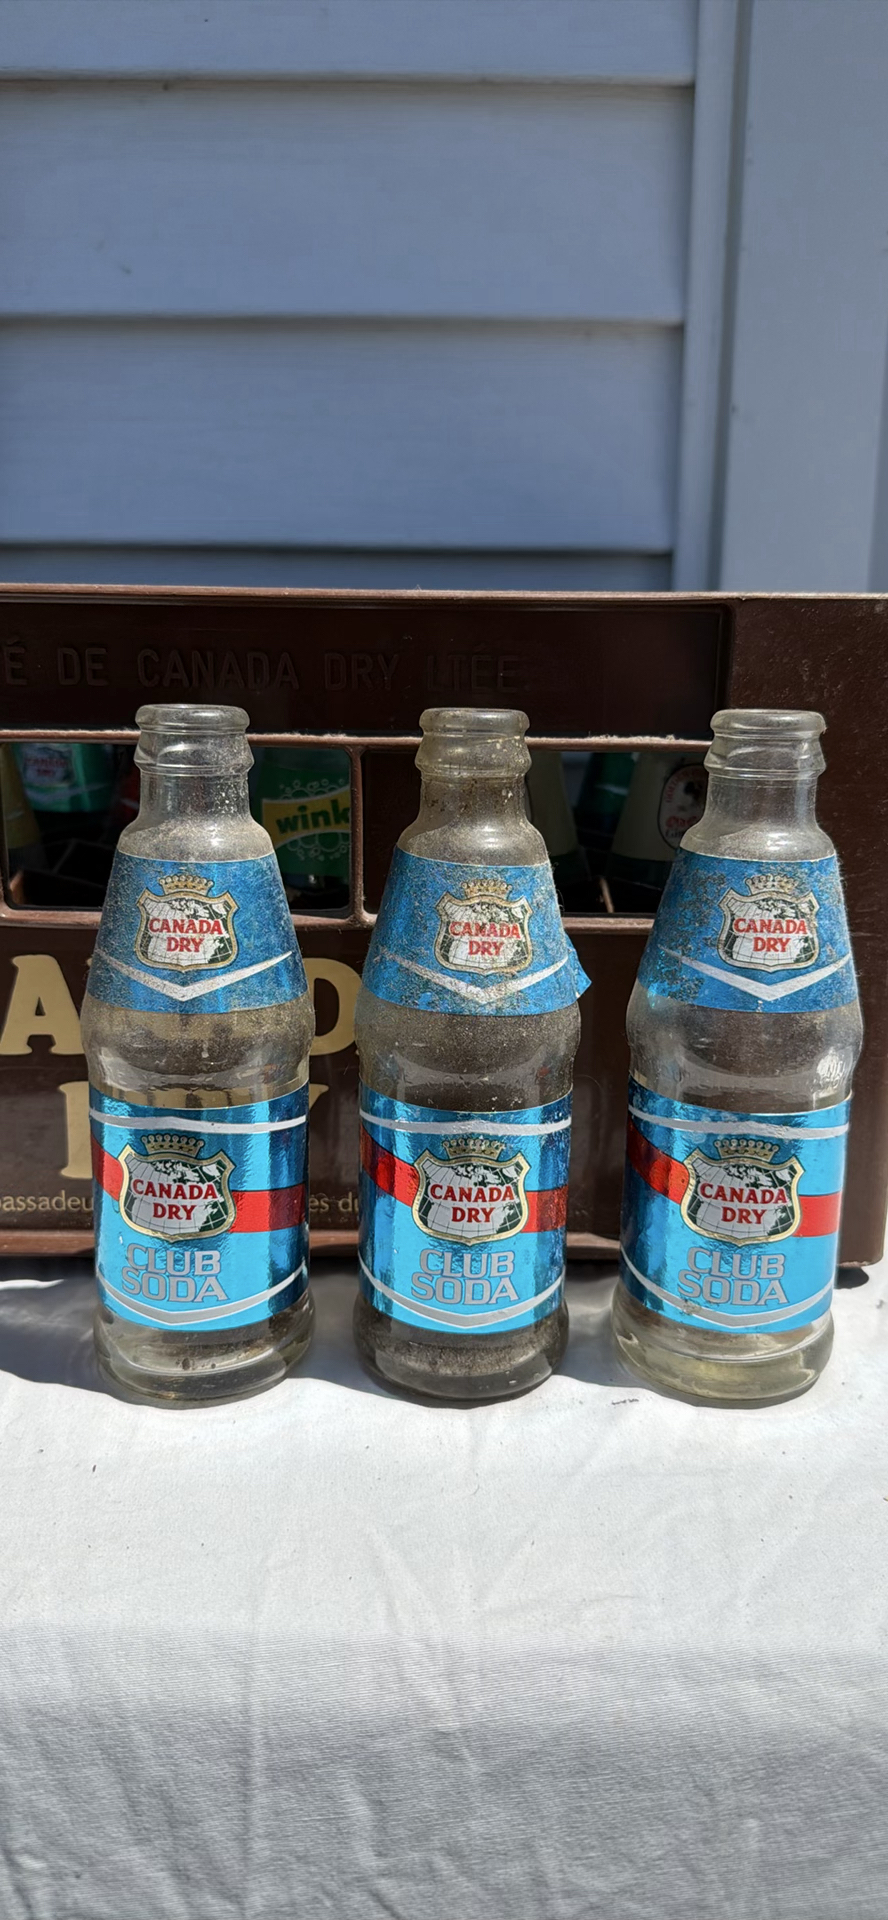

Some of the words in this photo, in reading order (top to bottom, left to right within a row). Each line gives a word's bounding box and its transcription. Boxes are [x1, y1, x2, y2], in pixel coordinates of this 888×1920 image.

[57, 647, 108, 686] DE
[136, 648, 300, 691] CANADA
[323, 653, 399, 691] DRY
[275, 799, 350, 835] wink
[148, 917, 224, 935] CANADA
[449, 921, 521, 939] CANADA
[733, 917, 808, 935] CANADA
[166, 936, 205, 953] DRY
[468, 940, 505, 956] DRY
[753, 936, 791, 953] DRY
[132, 1178, 218, 1200] CANADA
[430, 1183, 515, 1203] CANADA
[700, 1182, 788, 1205] CANADA
[0, 1190, 94, 1212] assadeu
[152, 1202, 198, 1221] DRY
[451, 1206, 496, 1223] DRY
[721, 1206, 768, 1225] DRY
[126, 1242, 221, 1277] CLUB
[420, 1248, 516, 1279] CLUB
[687, 1246, 786, 1280] CLUB
[121, 1265, 231, 1303] SODA
[411, 1271, 520, 1305] SODA
[677, 1268, 790, 1306] SODA
